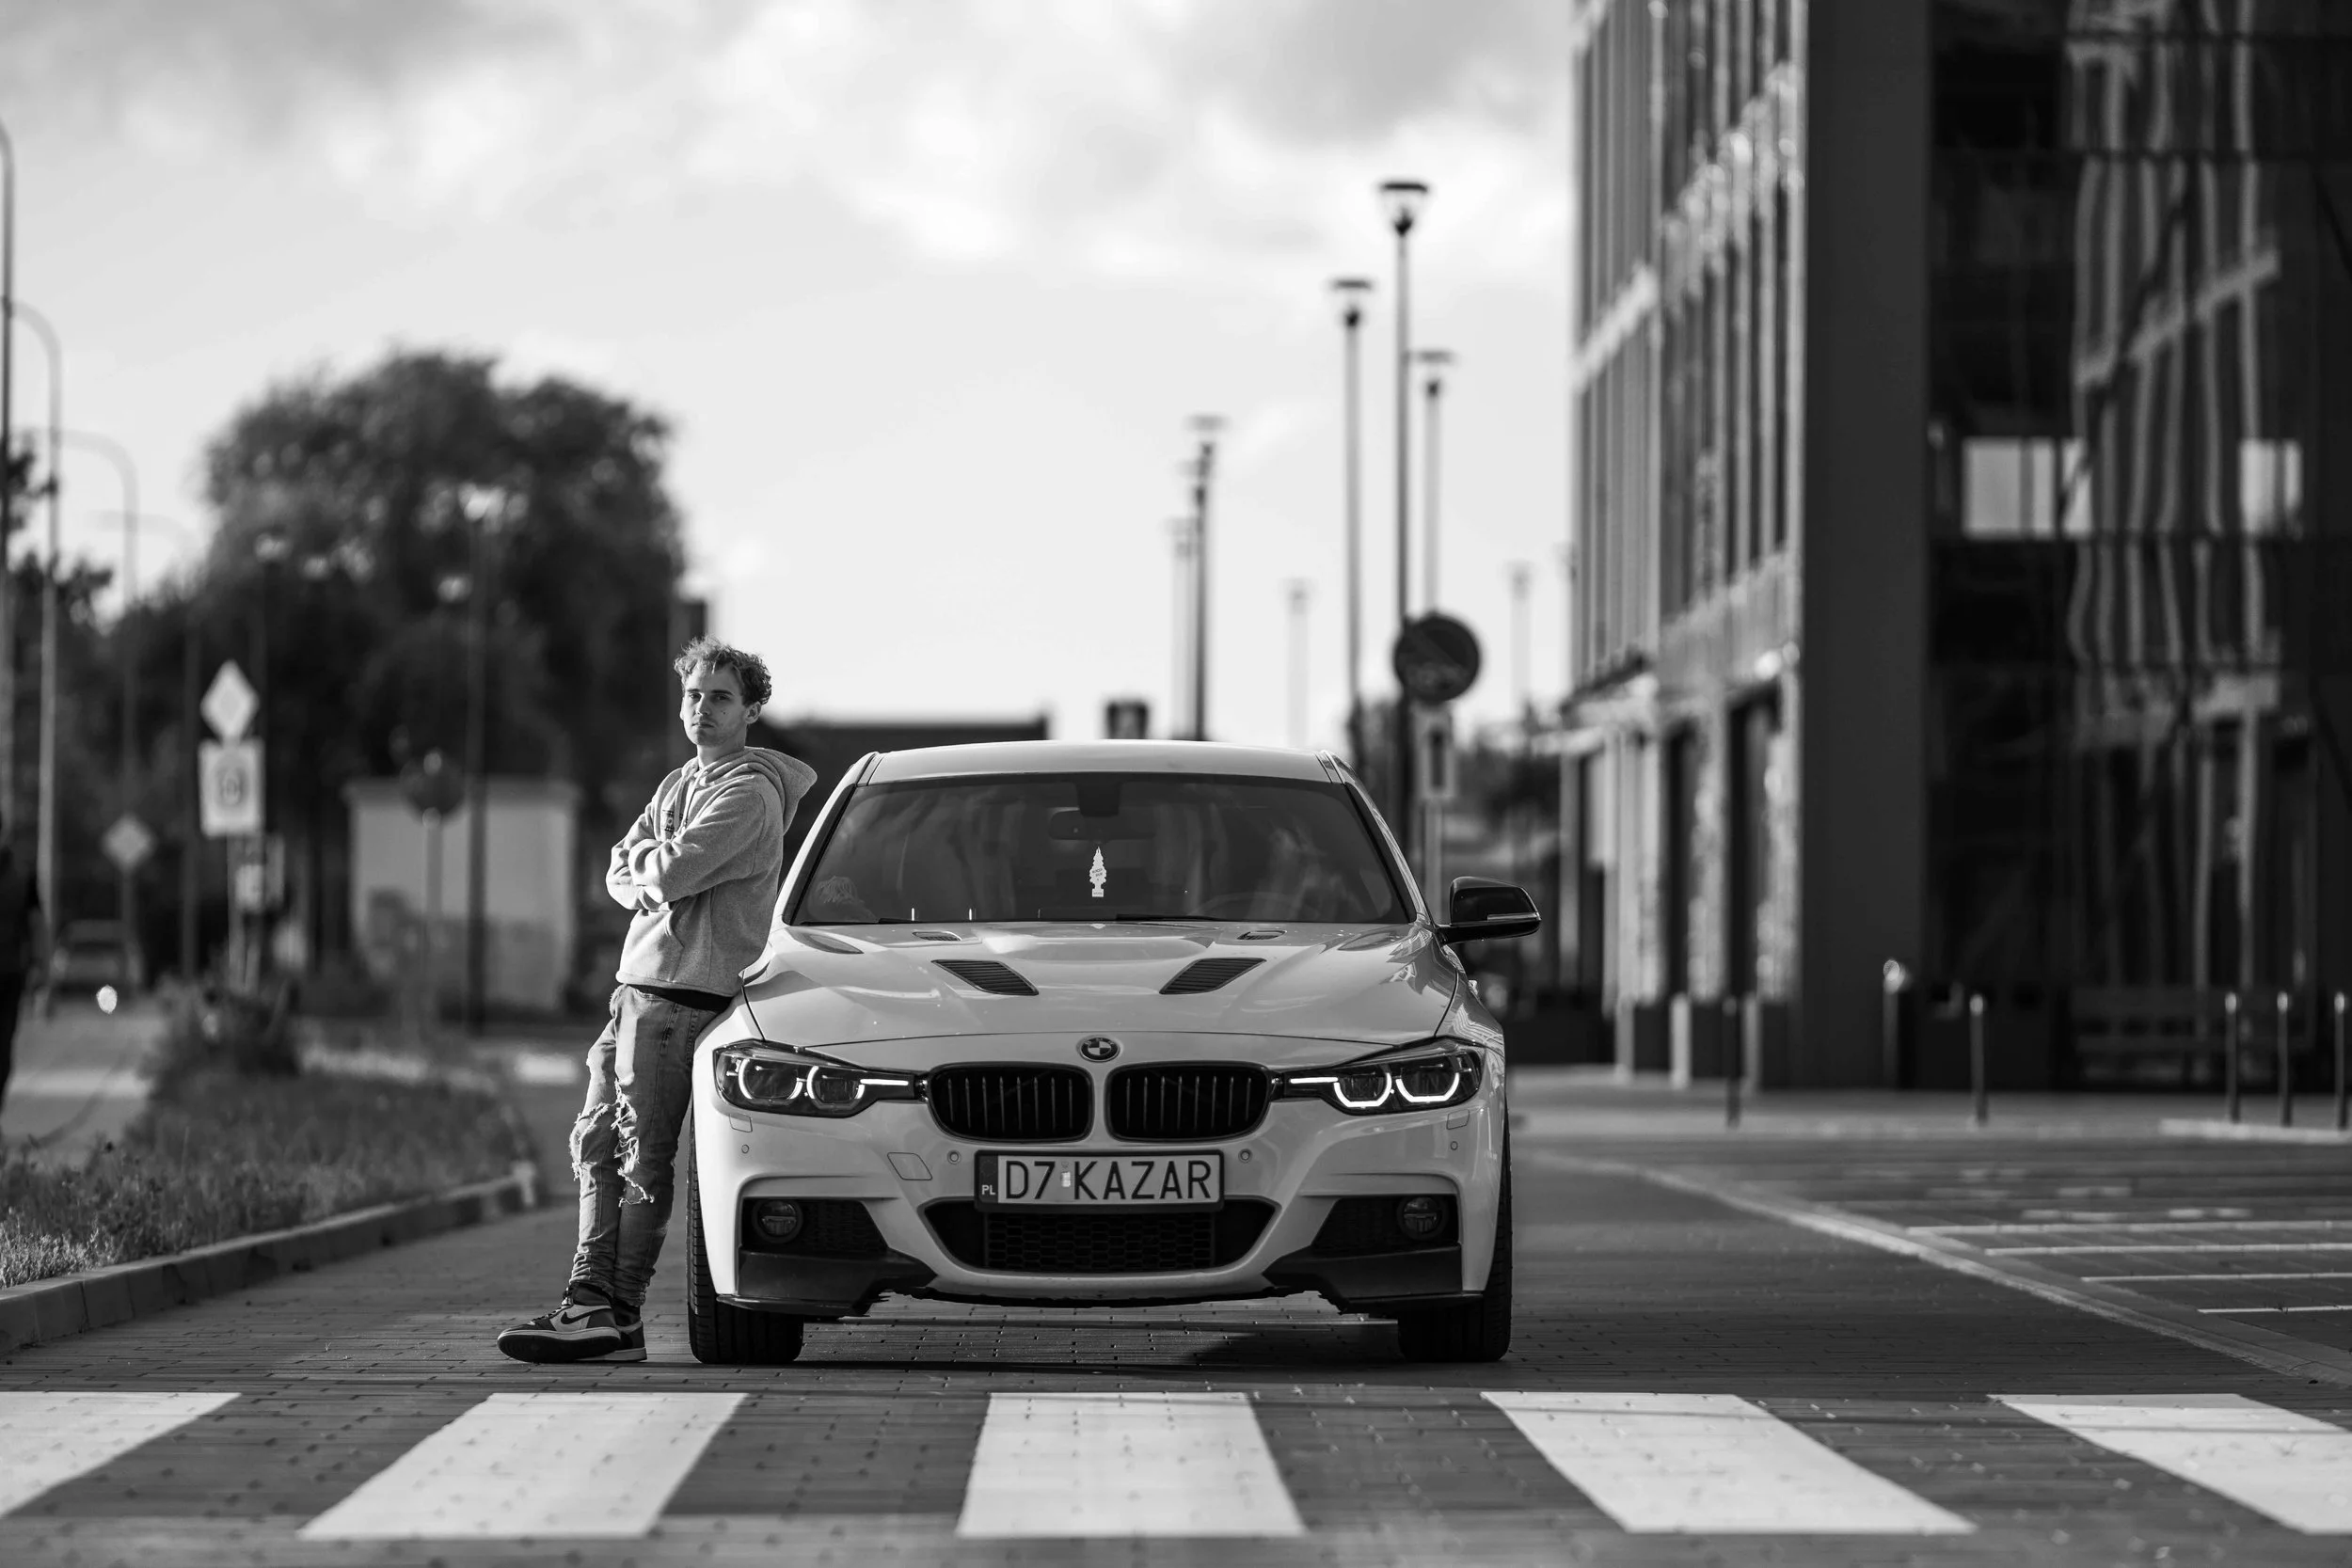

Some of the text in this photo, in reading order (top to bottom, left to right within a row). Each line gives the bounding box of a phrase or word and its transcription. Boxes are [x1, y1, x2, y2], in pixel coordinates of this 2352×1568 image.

[981, 1184, 996, 1196] PL
[1006, 1161, 1211, 1199] D7 KAZAR
